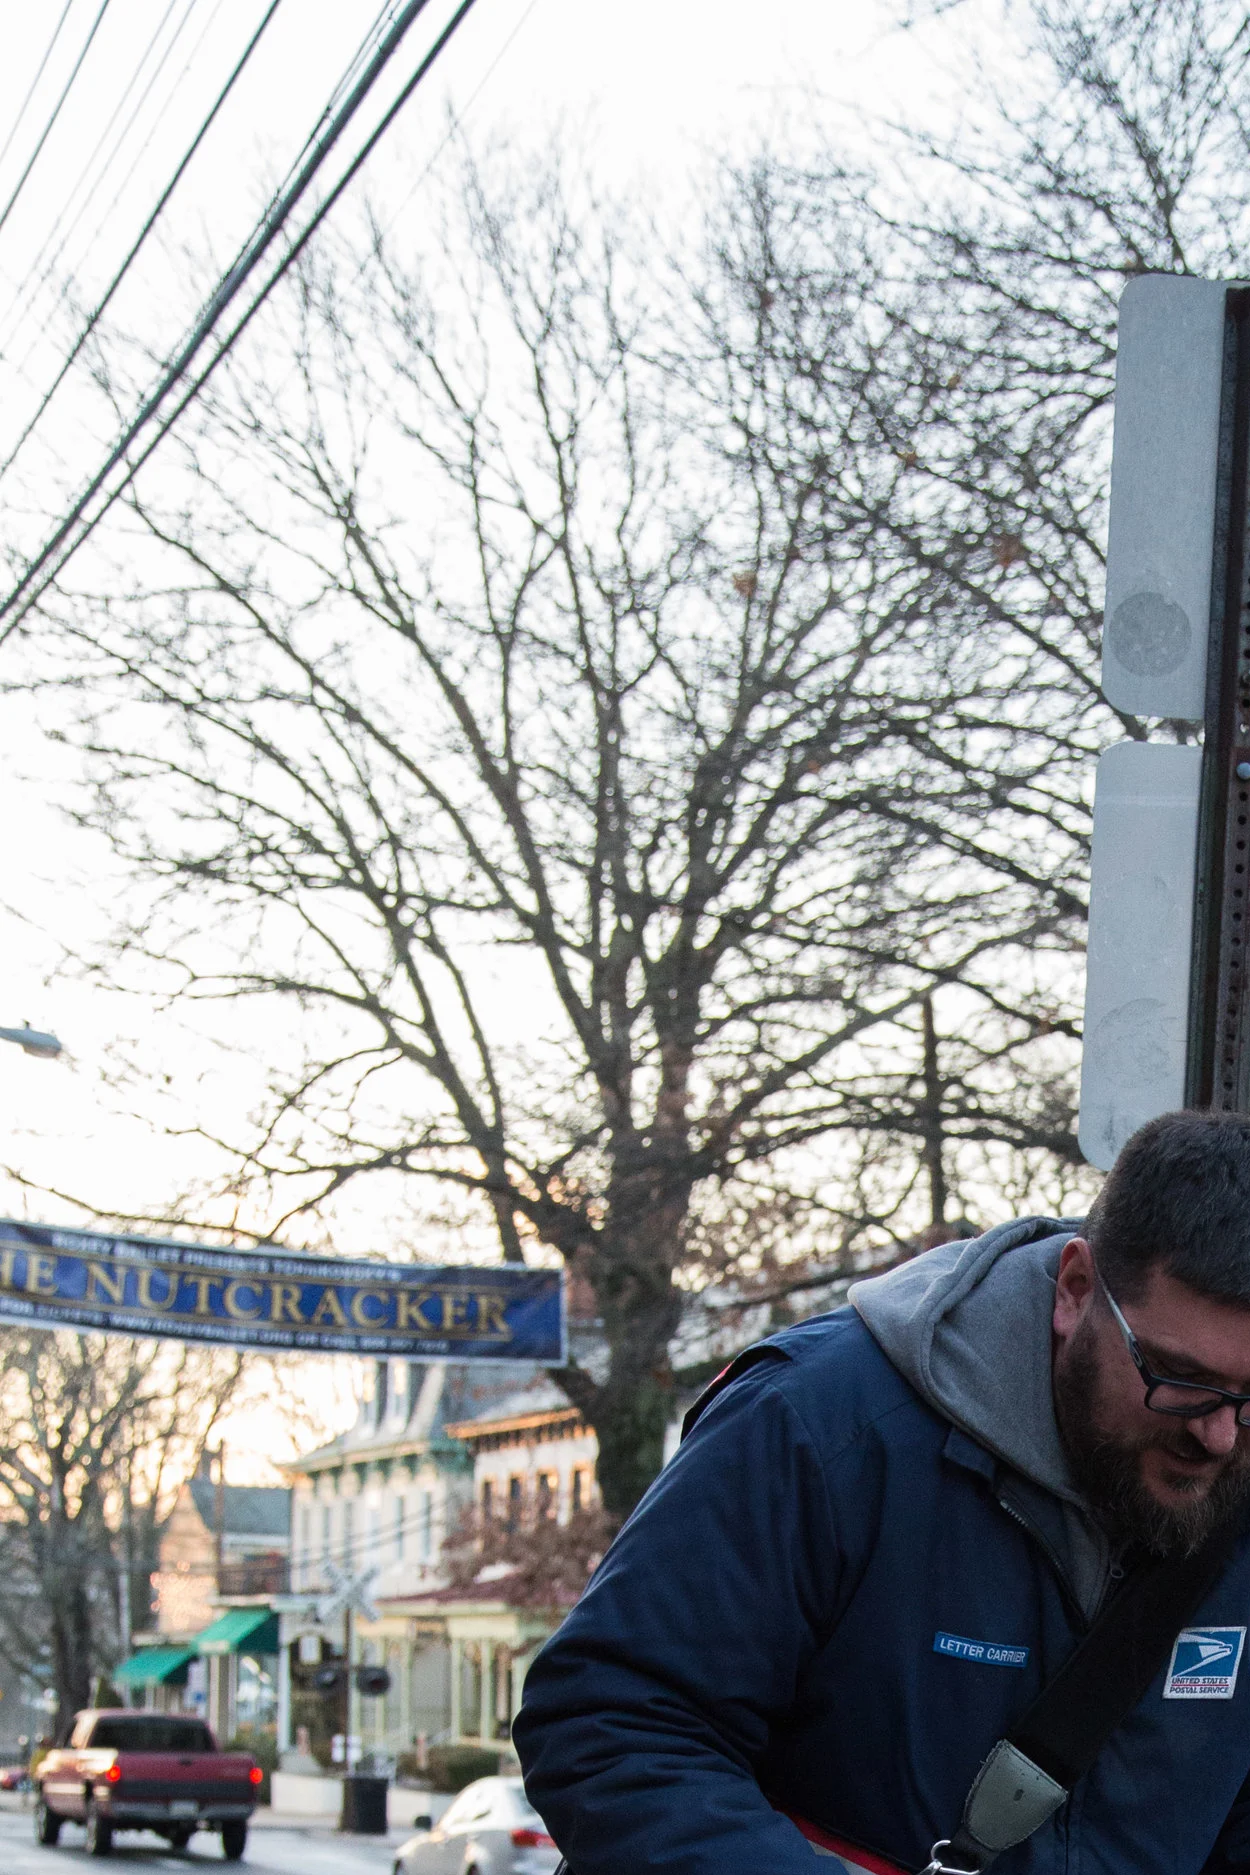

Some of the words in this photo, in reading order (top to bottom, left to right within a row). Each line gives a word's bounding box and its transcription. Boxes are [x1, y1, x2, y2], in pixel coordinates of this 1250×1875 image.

[84, 1261, 515, 1334] NUTCRACKER
[940, 1637, 985, 1659] LETTER
[987, 1647, 1026, 1664] CARRIER
[1172, 1677, 1201, 1685] UNITED
[1202, 1676, 1229, 1685] STATES
[1169, 1686, 1198, 1695] POSTAL
[1199, 1686, 1230, 1695] SERVICE
